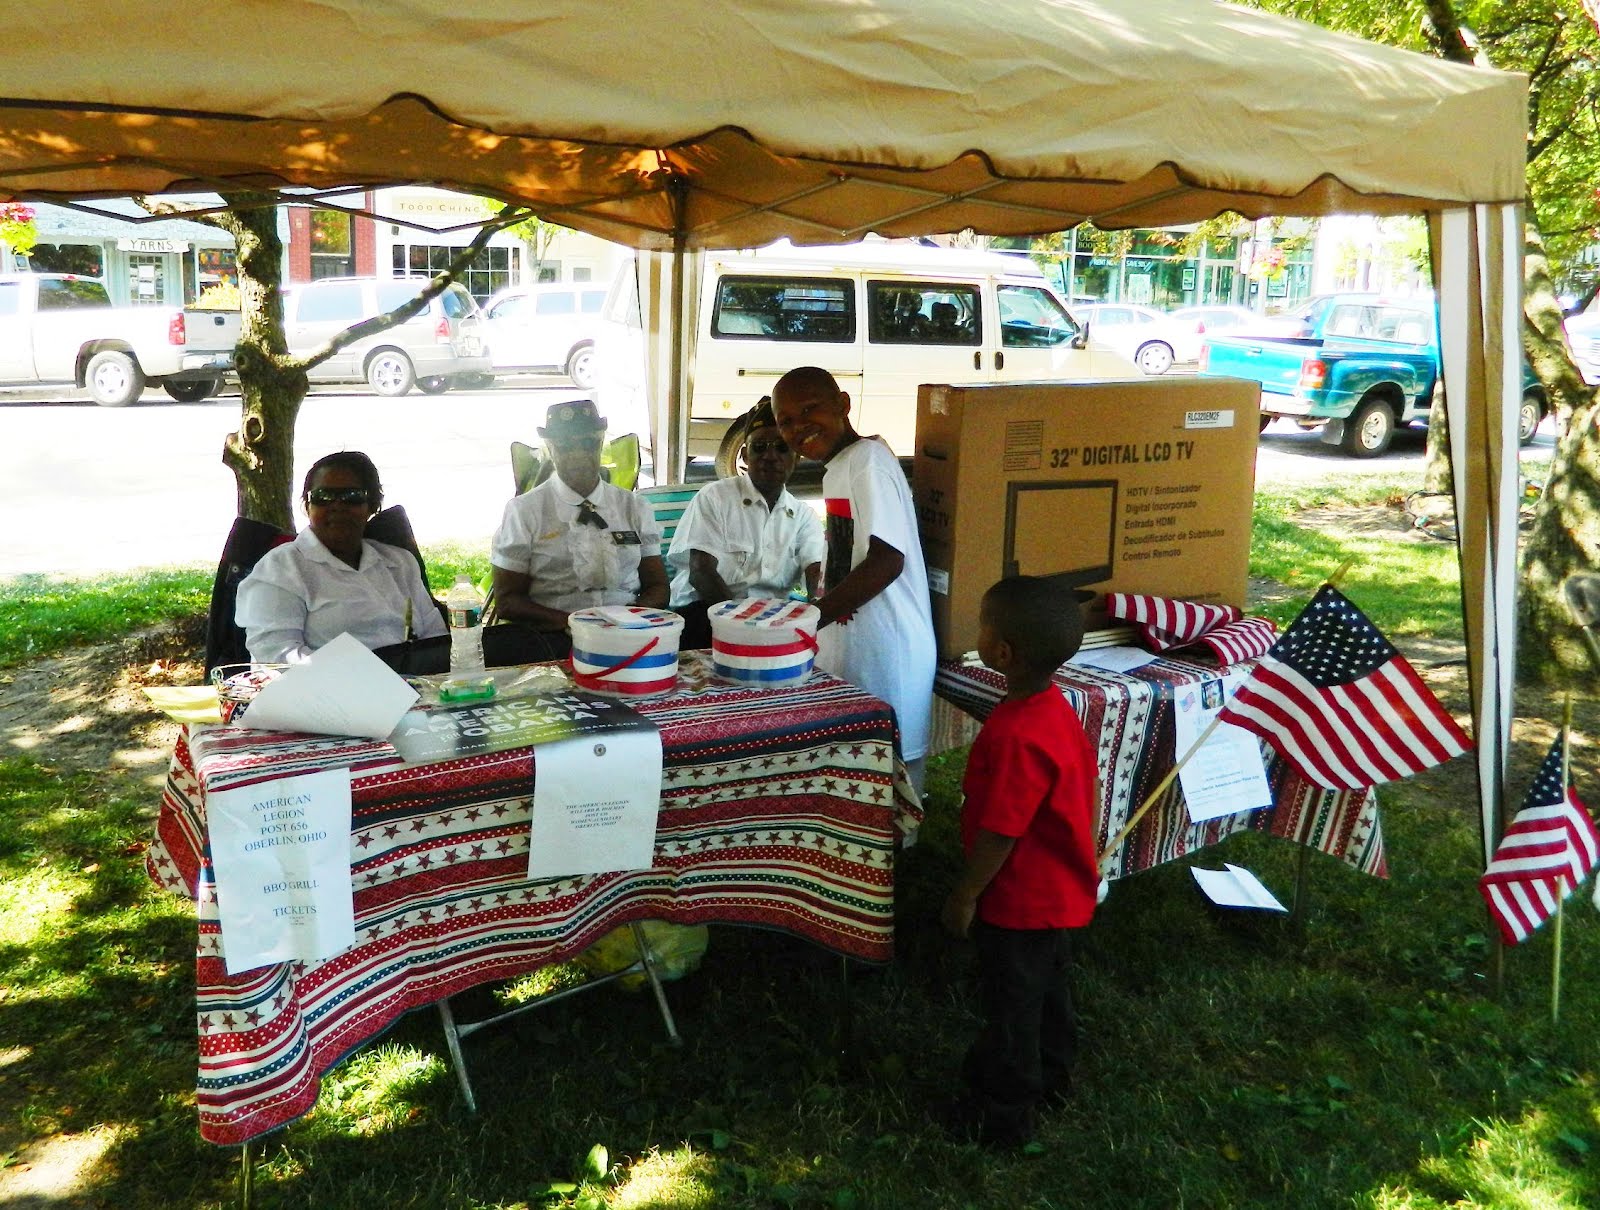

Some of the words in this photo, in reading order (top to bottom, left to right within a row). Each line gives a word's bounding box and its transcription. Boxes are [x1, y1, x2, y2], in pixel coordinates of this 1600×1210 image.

[131, 240, 174, 251] YARNS
[1050, 448, 1078, 468] 32"
[1083, 444, 1139, 466] DIGITAL
[1145, 442, 1171, 462] LCD
[1177, 441, 1194, 460] TV
[1126, 488, 1148, 497] HDTV
[1155, 484, 1202, 495] Sintonizador
[1126, 503, 1151, 514] Digital
[1152, 500, 1197, 511] Incorporado
[1125, 519, 1154, 529] Entrada
[1157, 517, 1176, 526] HDMI
[1124, 533, 1175, 545] Decodificador
[1178, 532, 1187, 540] de
[1123, 551, 1150, 561] Control
[1153, 549, 1182, 558] Remoto
[428, 696, 580, 724] AFRICAN
[405, 701, 612, 737] AMERICANS
[463, 711, 599, 737] OBAMA
[252, 794, 312, 812] AMERICAN
[263, 808, 304, 822] LEGION
[261, 824, 287, 835] POST
[291, 822, 308, 831] 656
[299, 831, 327, 843] OHIO
[263, 882, 288, 894] BBQ
[289, 880, 319, 889] GRILL
[273, 906, 317, 917] TICKETS
